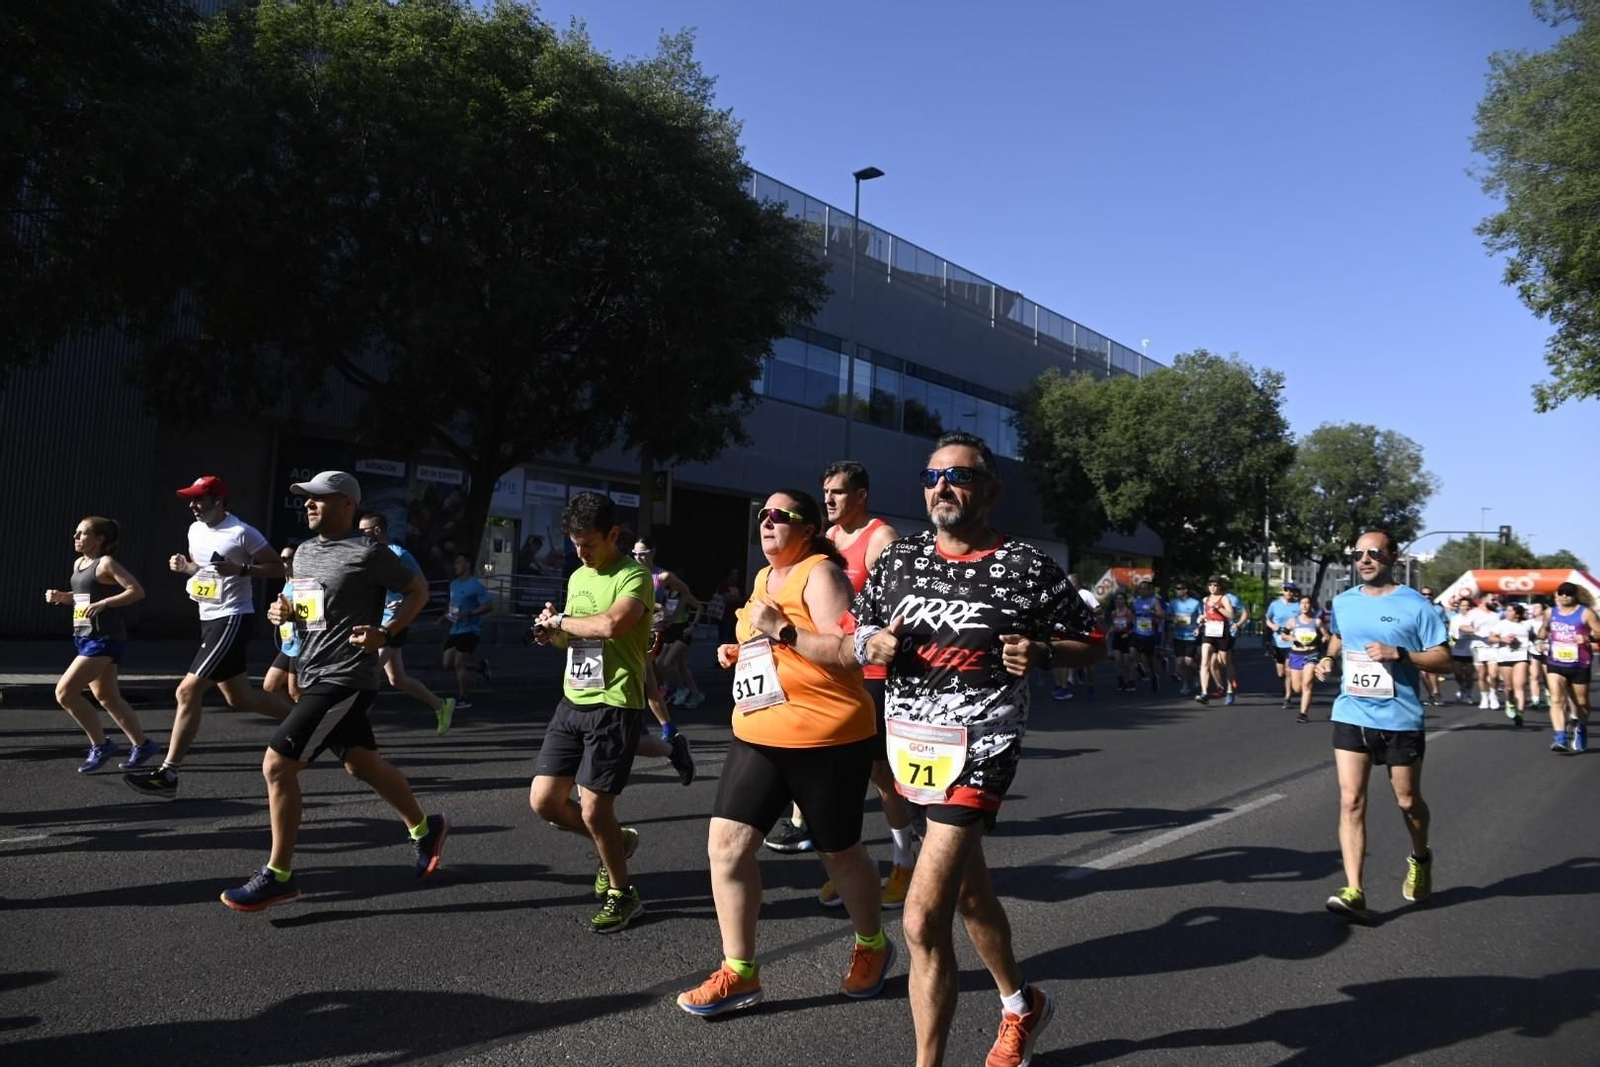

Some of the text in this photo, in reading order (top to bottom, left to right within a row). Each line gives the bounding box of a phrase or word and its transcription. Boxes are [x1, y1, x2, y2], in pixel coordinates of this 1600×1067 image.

[197, 586, 210, 596] 27
[890, 594, 995, 636] CORRE
[735, 674, 764, 700] 317
[1352, 673, 1381, 687] 467
[909, 742, 936, 753] GOfit
[908, 763, 936, 787] 71
